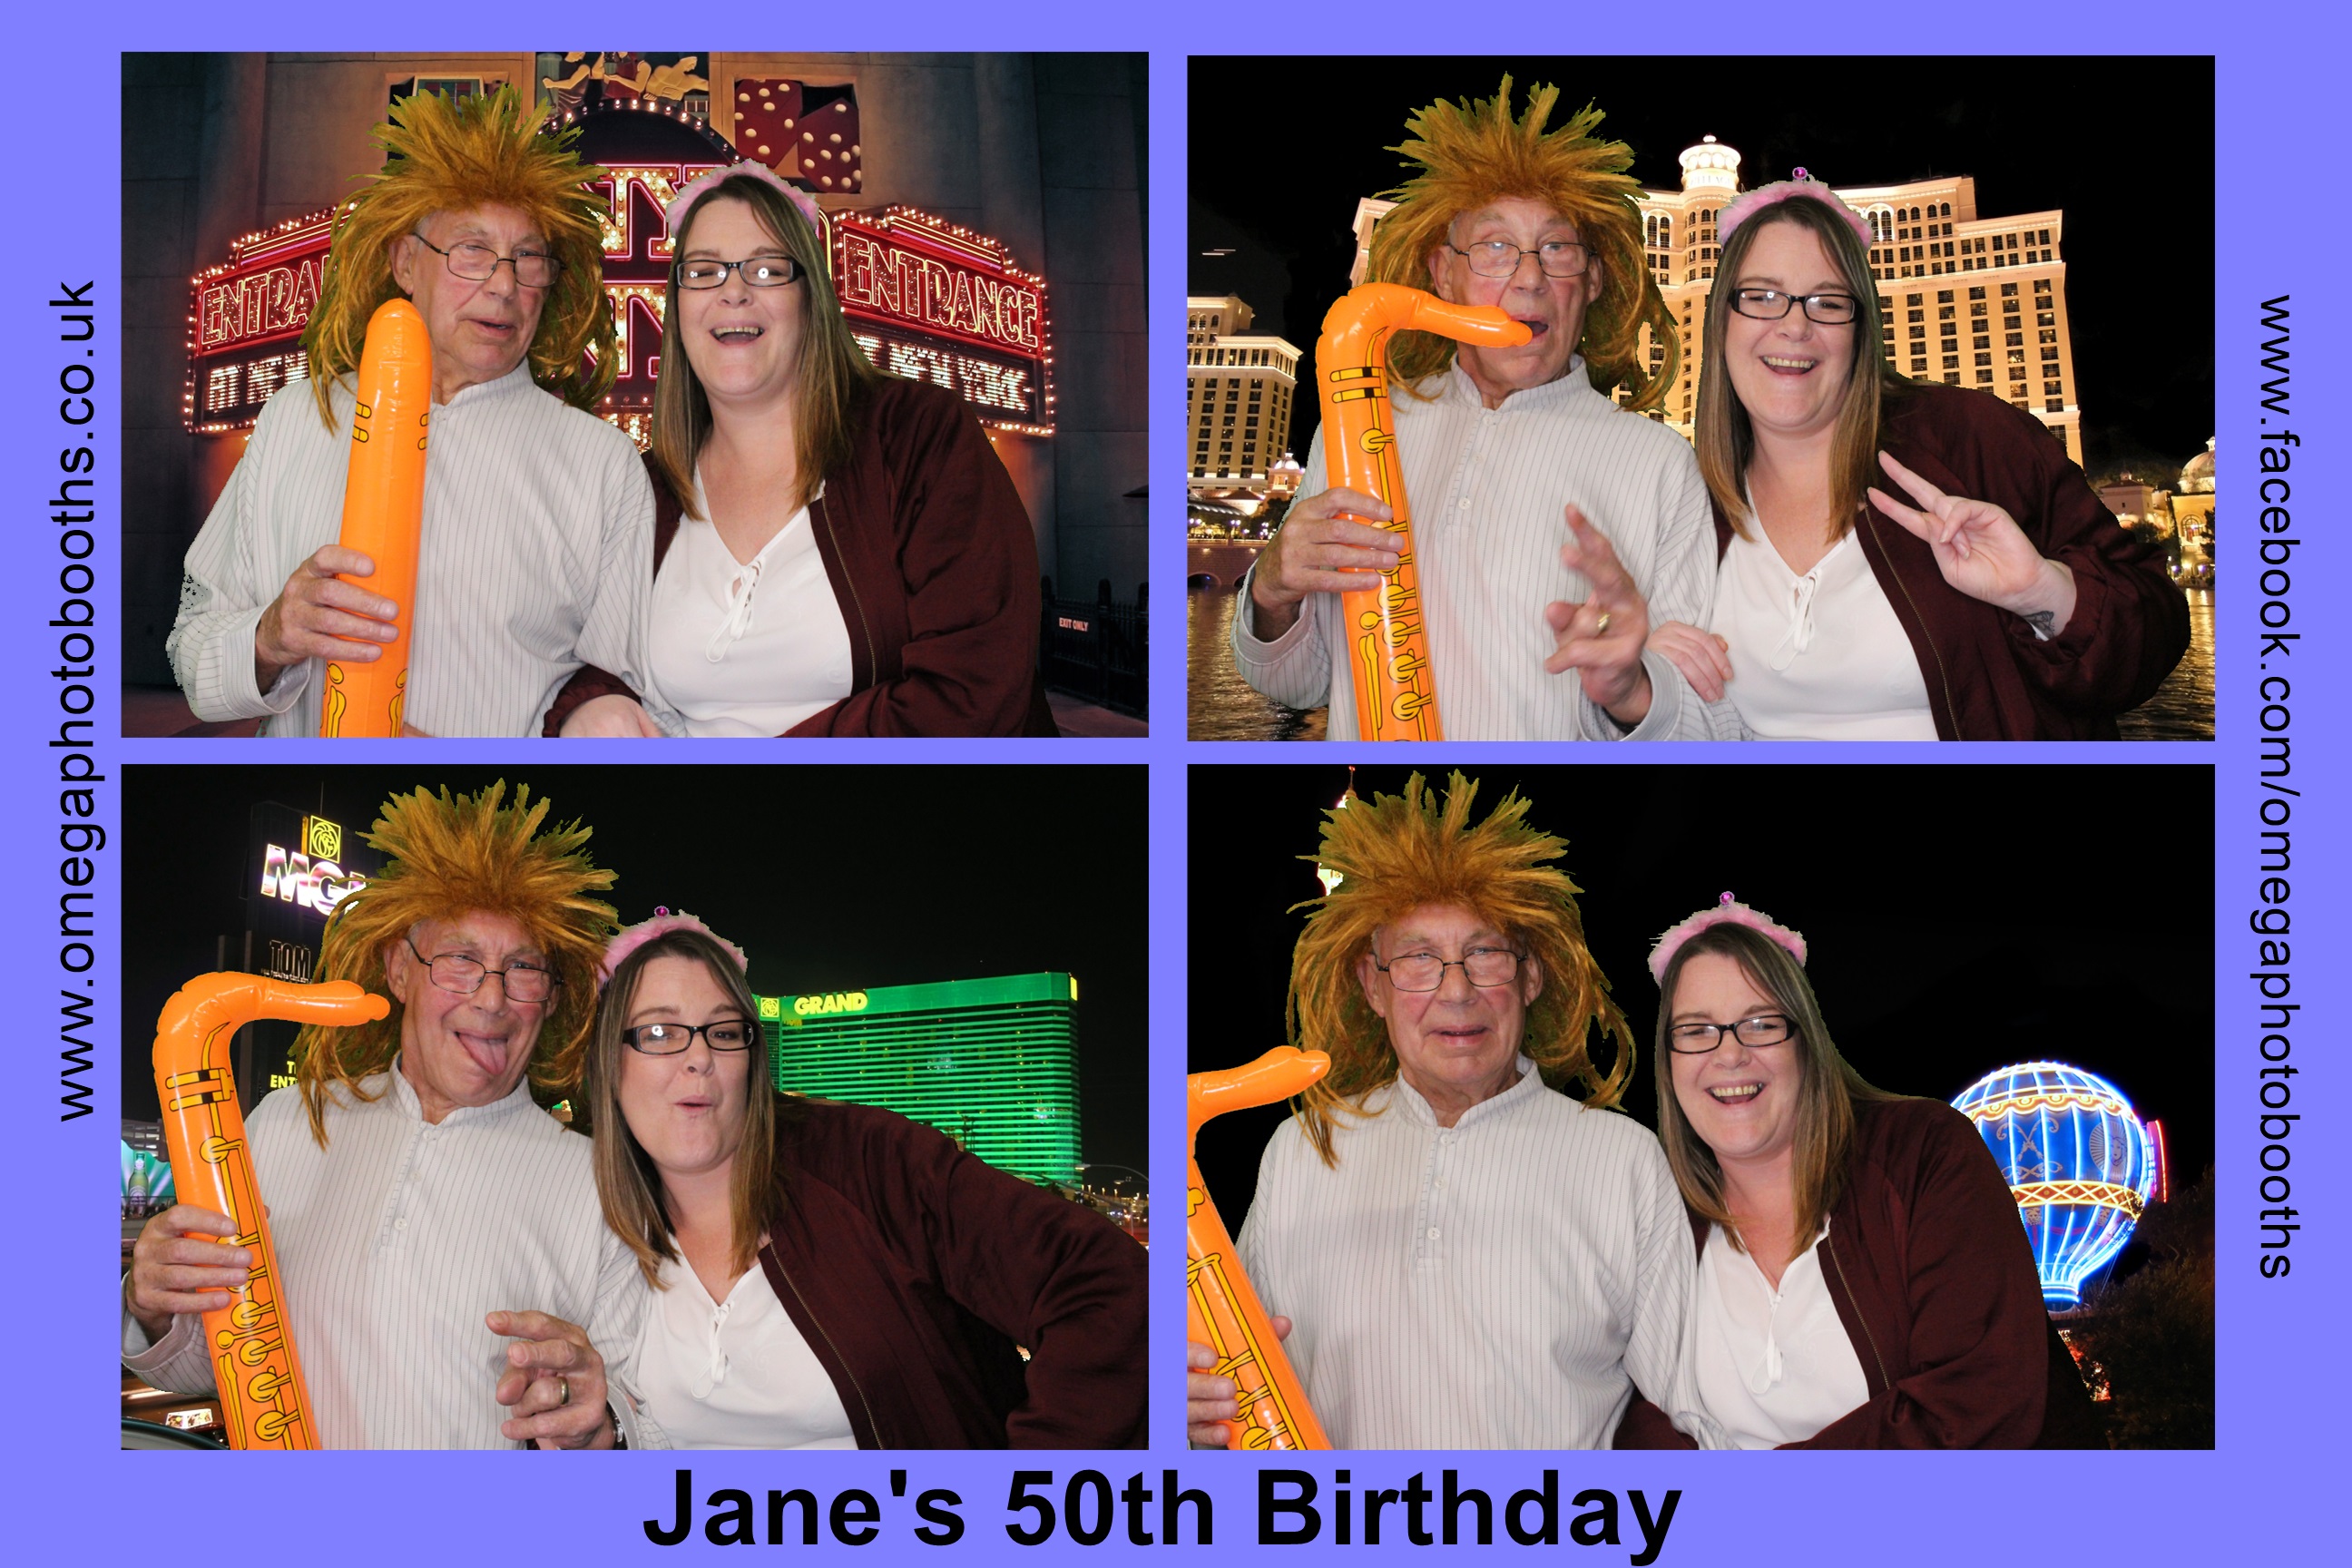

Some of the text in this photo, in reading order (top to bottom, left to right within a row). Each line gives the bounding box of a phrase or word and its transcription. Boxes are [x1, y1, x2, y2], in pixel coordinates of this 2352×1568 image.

[201, 254, 330, 345] ENTRA
[843, 233, 1038, 348] ENTRANCE
[1059, 617, 1089, 632] EXIT ONLY
[794, 992, 867, 1015] GRAND
[270, 1074, 299, 1089] ENT
